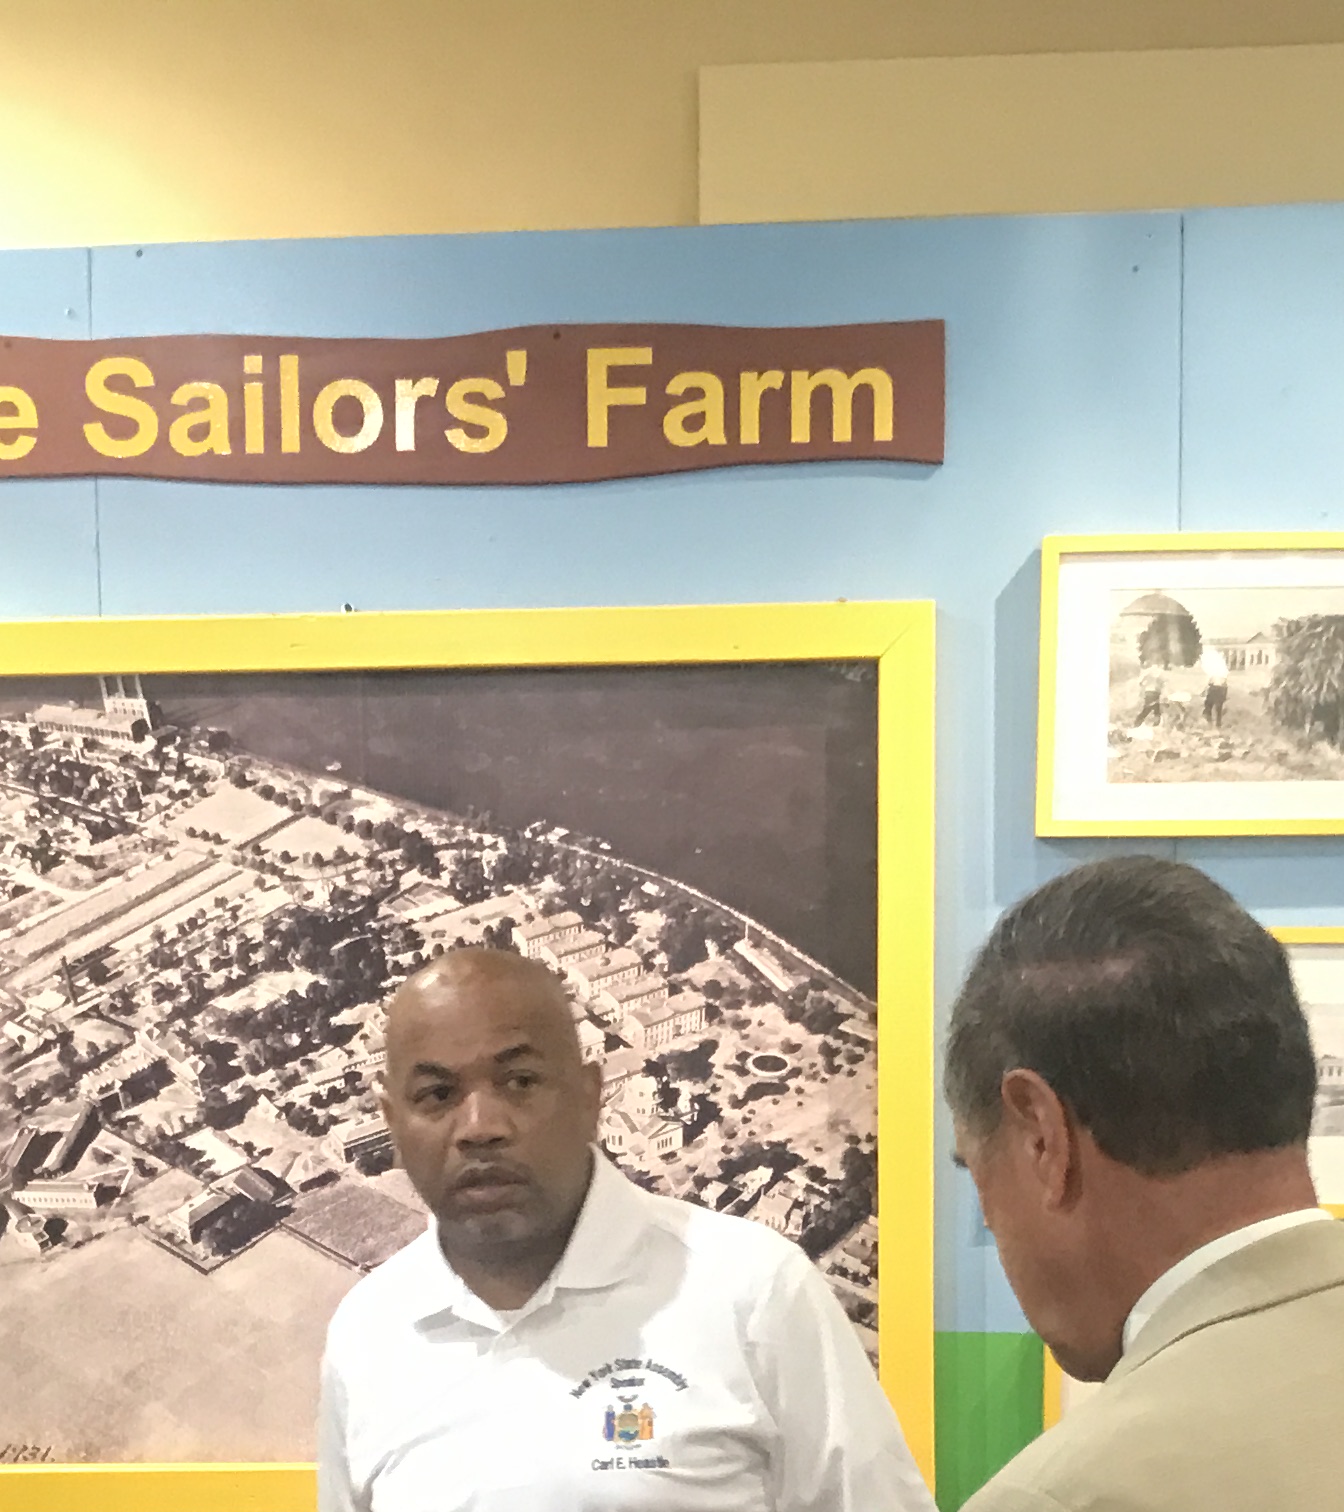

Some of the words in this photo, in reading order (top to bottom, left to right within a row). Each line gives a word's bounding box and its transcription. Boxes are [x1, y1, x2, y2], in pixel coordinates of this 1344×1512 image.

[82, 349, 530, 457] Sailors'
[586, 346, 897, 449] Farm
[591, 1457, 614, 1471] Carl
